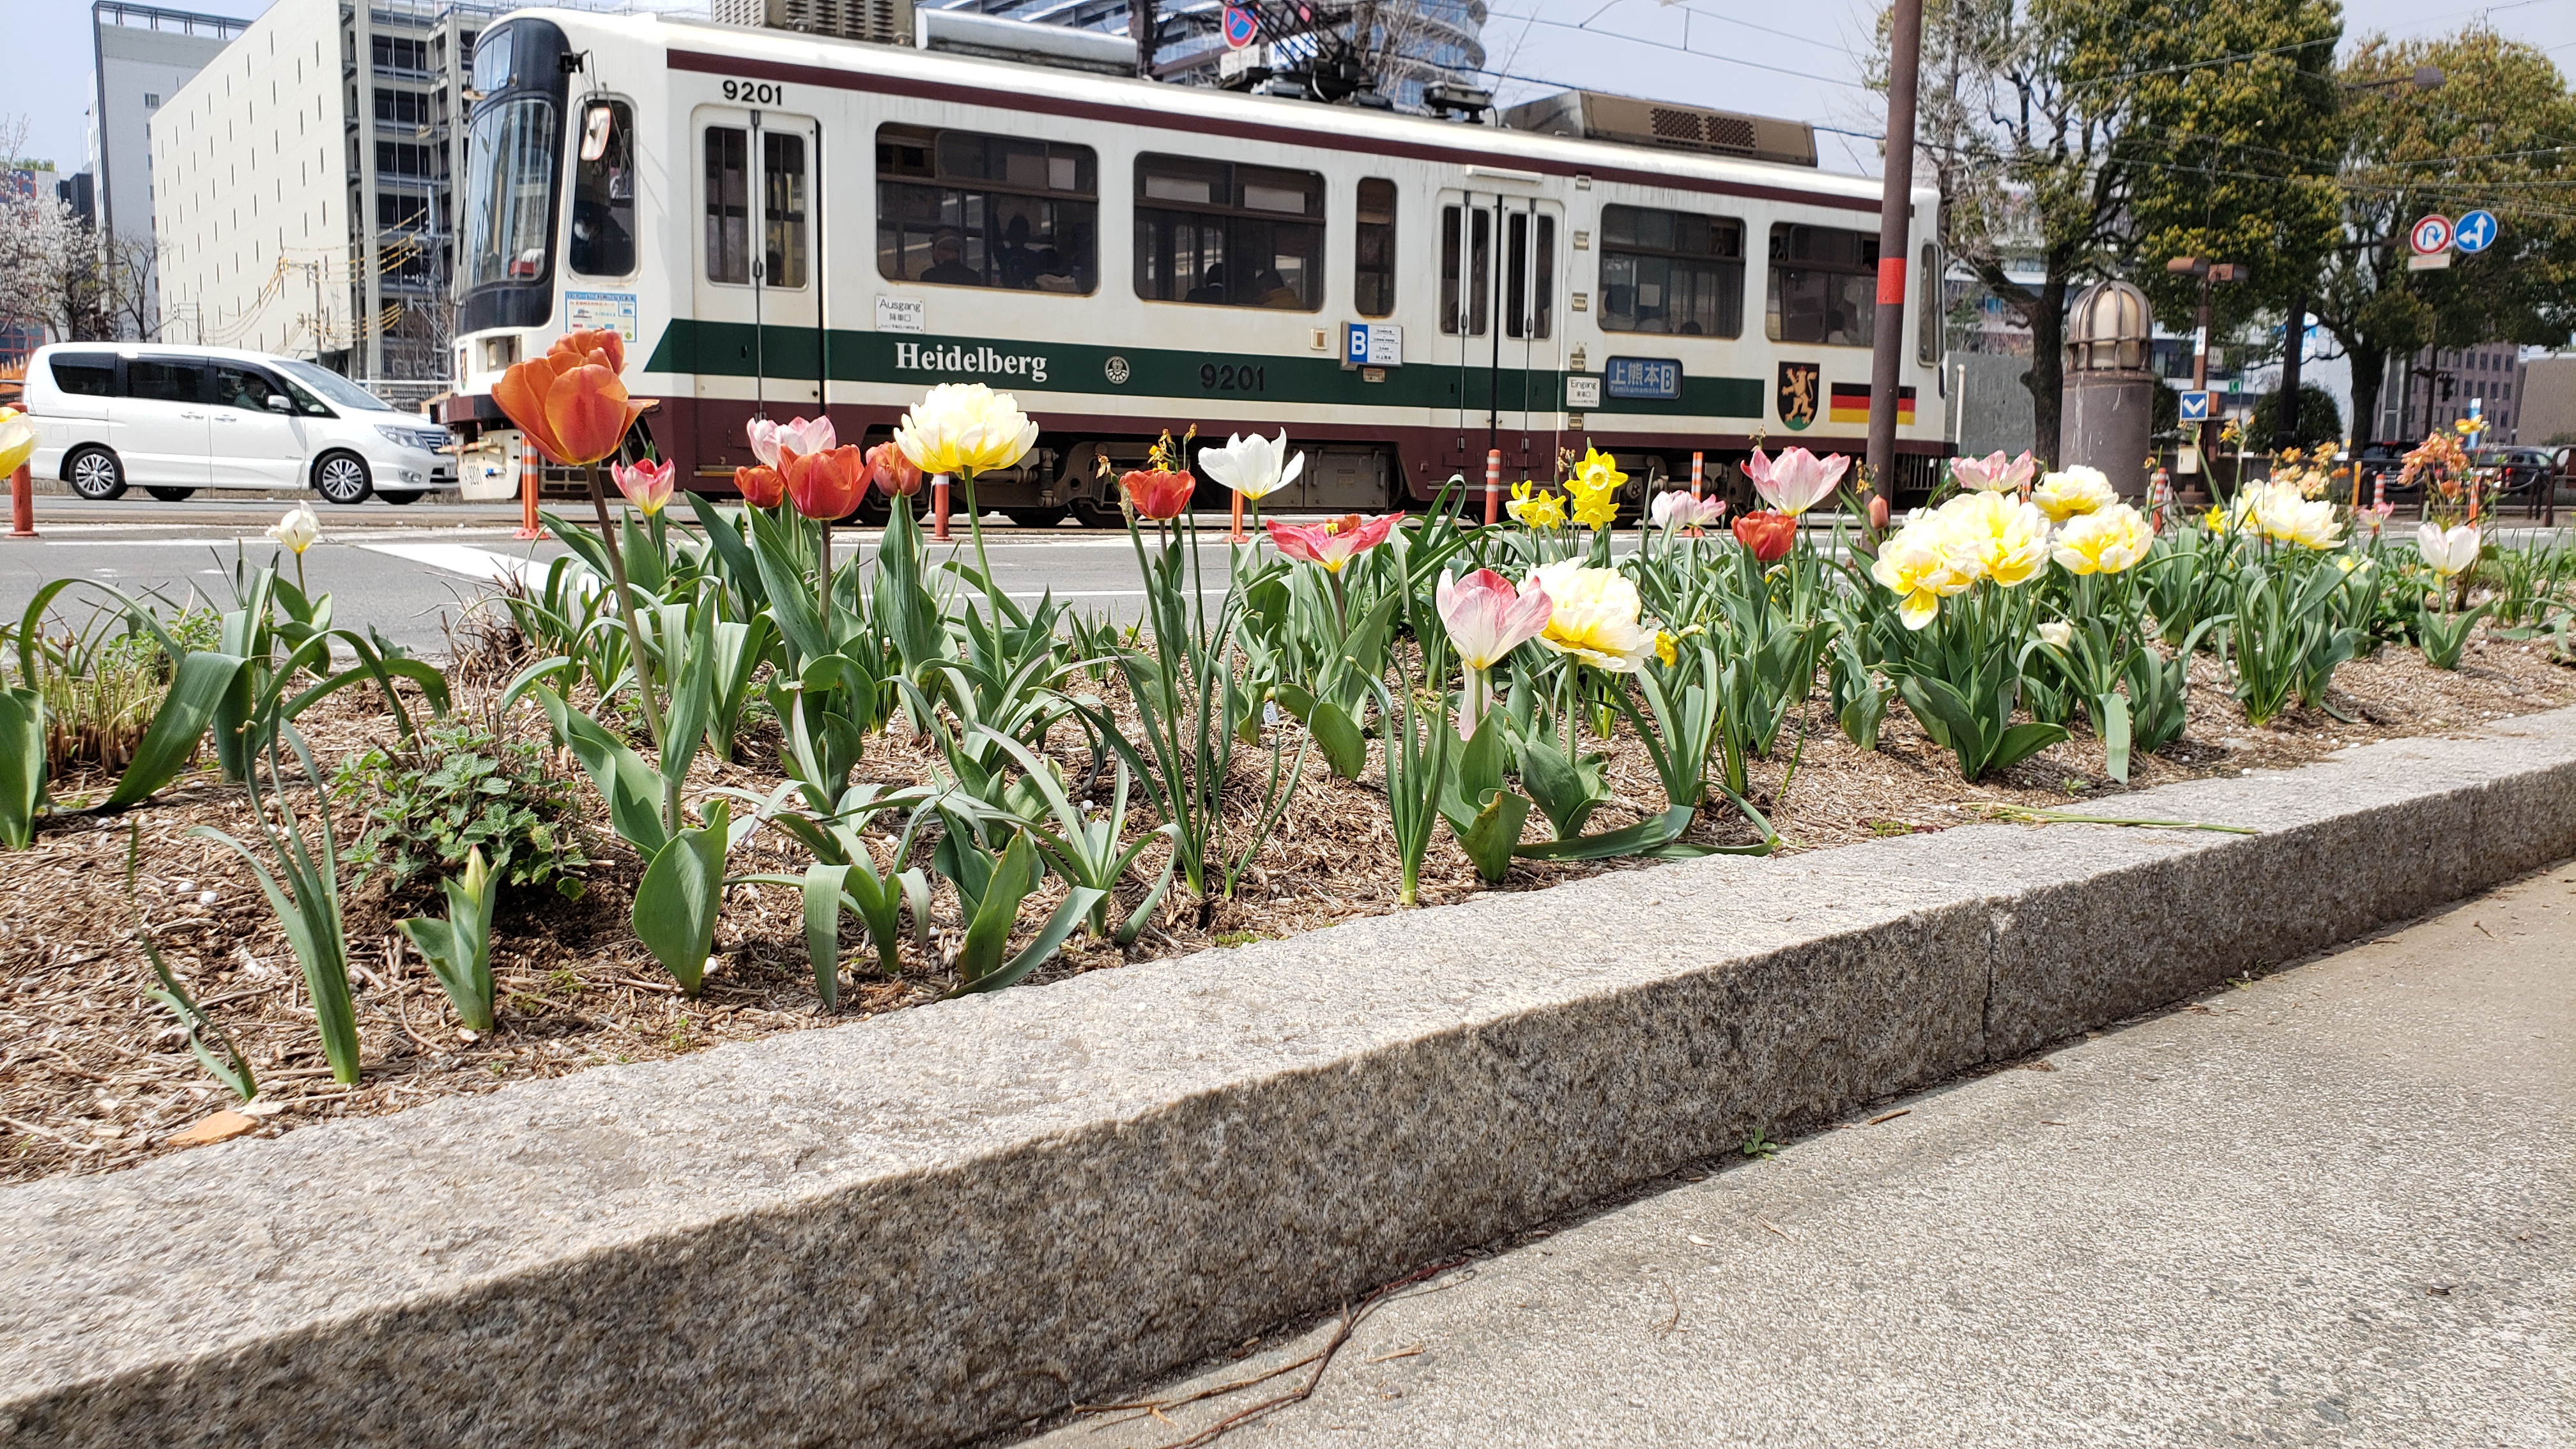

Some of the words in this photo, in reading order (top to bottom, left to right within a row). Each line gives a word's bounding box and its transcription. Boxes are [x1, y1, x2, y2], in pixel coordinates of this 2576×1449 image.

[723, 80, 781, 105] 9201
[879, 298, 921, 312] Ausgang
[1351, 330, 1366, 355] B
[895, 342, 1047, 382] Heidelberg
[1200, 363, 1264, 391] 9201
[1570, 379, 1596, 390] Eingang
[1611, 361, 1659, 387] 上熊本
[1664, 368, 1671, 390] B
[468, 464, 482, 486] 9201
